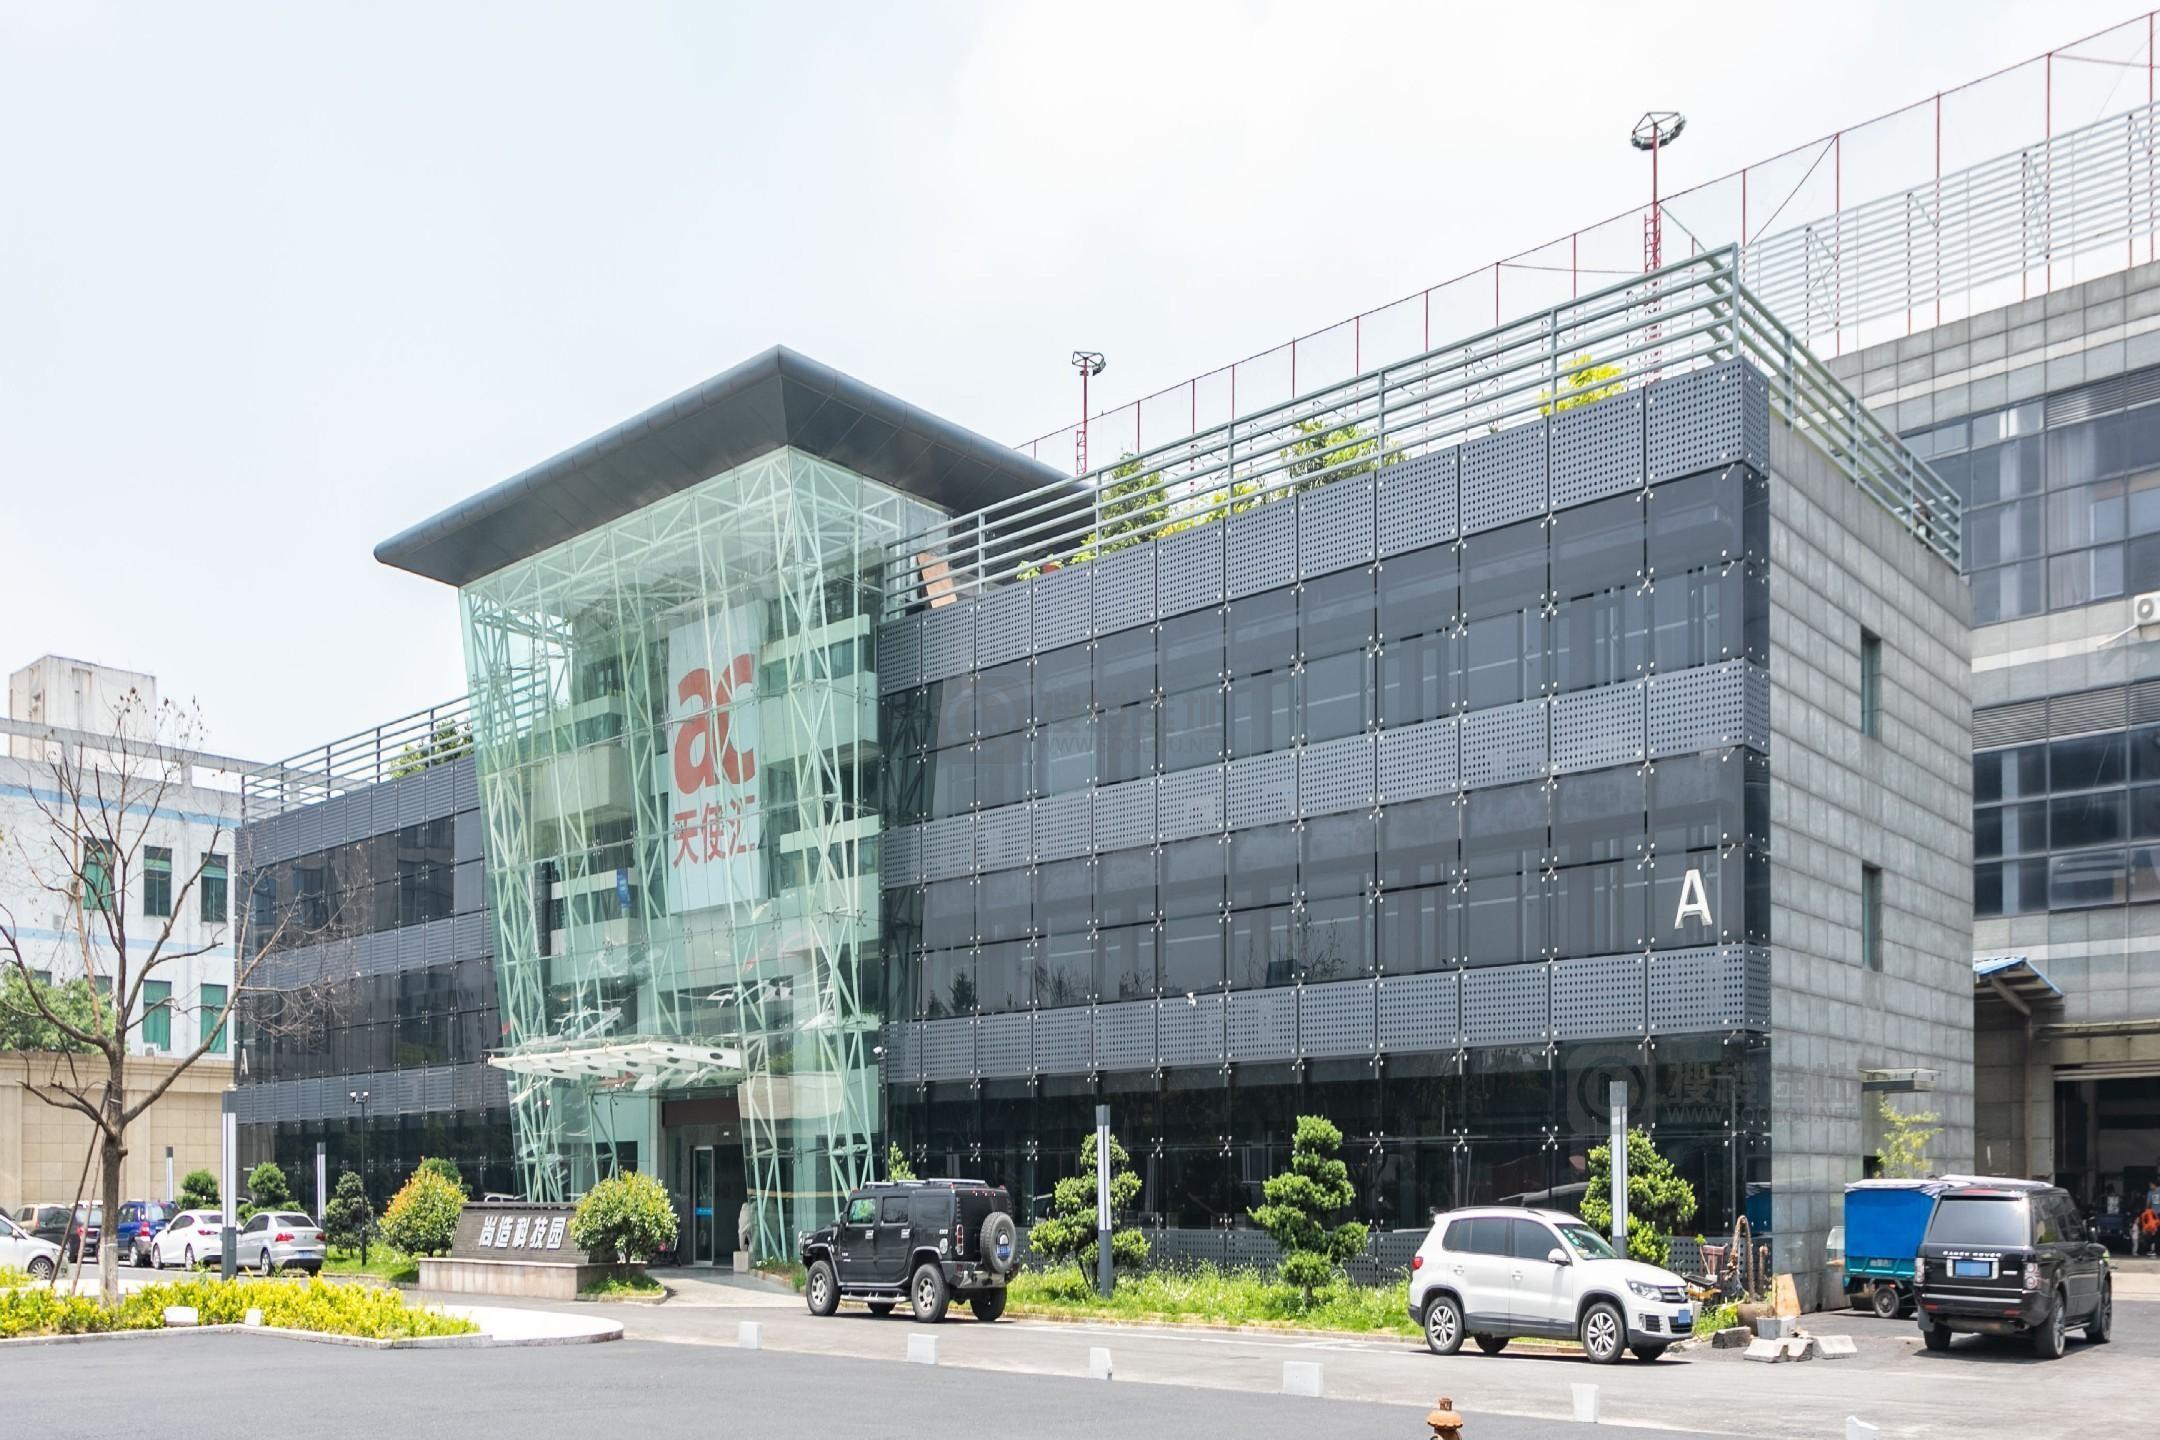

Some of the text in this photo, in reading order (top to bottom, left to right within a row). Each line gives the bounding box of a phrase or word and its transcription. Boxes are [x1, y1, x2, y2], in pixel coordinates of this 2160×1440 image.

[674, 653, 756, 795] ac
[673, 795, 756, 869] 天使汇
[1674, 868, 1713, 929] A
[239, 1048, 249, 1076] A
[479, 1216, 567, 1249] 尚造科技园
